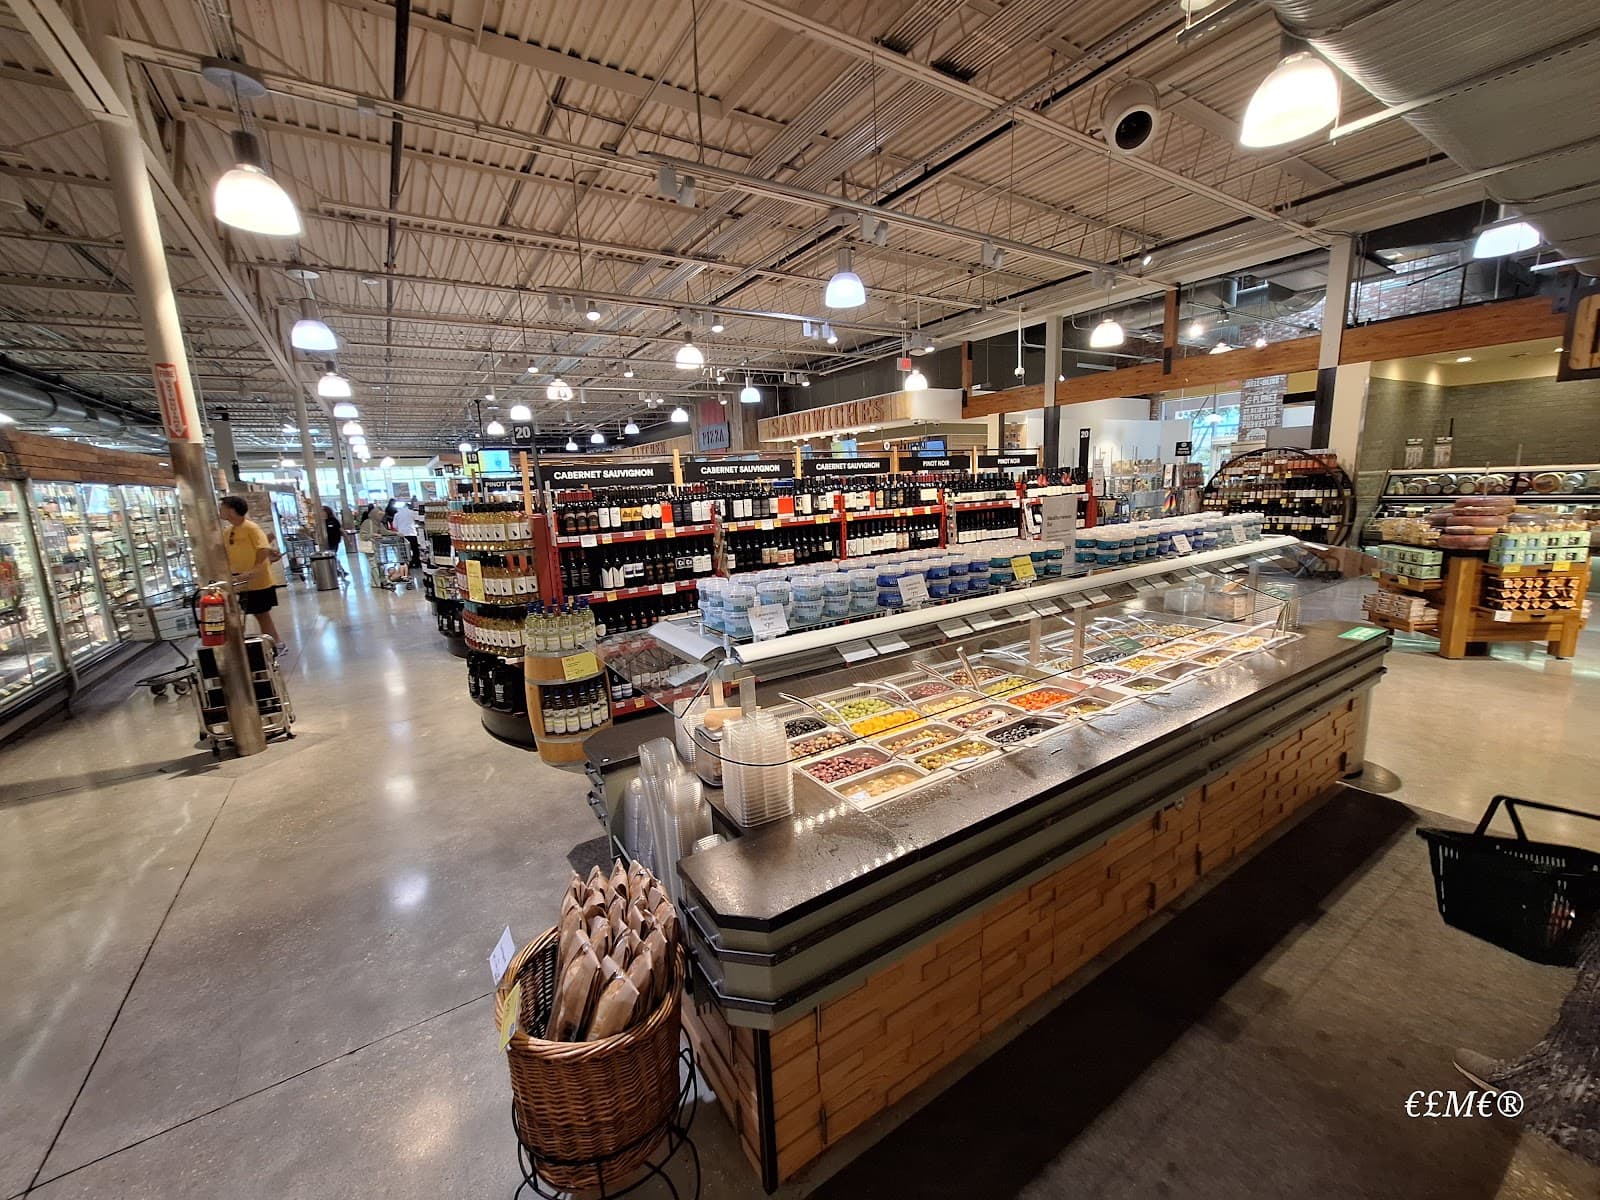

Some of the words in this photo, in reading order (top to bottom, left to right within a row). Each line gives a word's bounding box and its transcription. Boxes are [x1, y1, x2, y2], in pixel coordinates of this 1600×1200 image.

[769, 398, 884, 438] SANDWICHES
[514, 426, 531, 439] 20
[702, 428, 725, 444] PIZZA
[1081, 430, 1089, 439] 20
[467, 453, 478, 462] 19
[700, 465, 738, 475] CABERNET
[739, 464, 780, 473] SAUVIGNON
[815, 462, 847, 471] CABERNET
[847, 461, 880, 470] SAUVIGNON
[553, 469, 602, 480] CABERNET
[603, 468, 654, 479] SAUVIGNON
